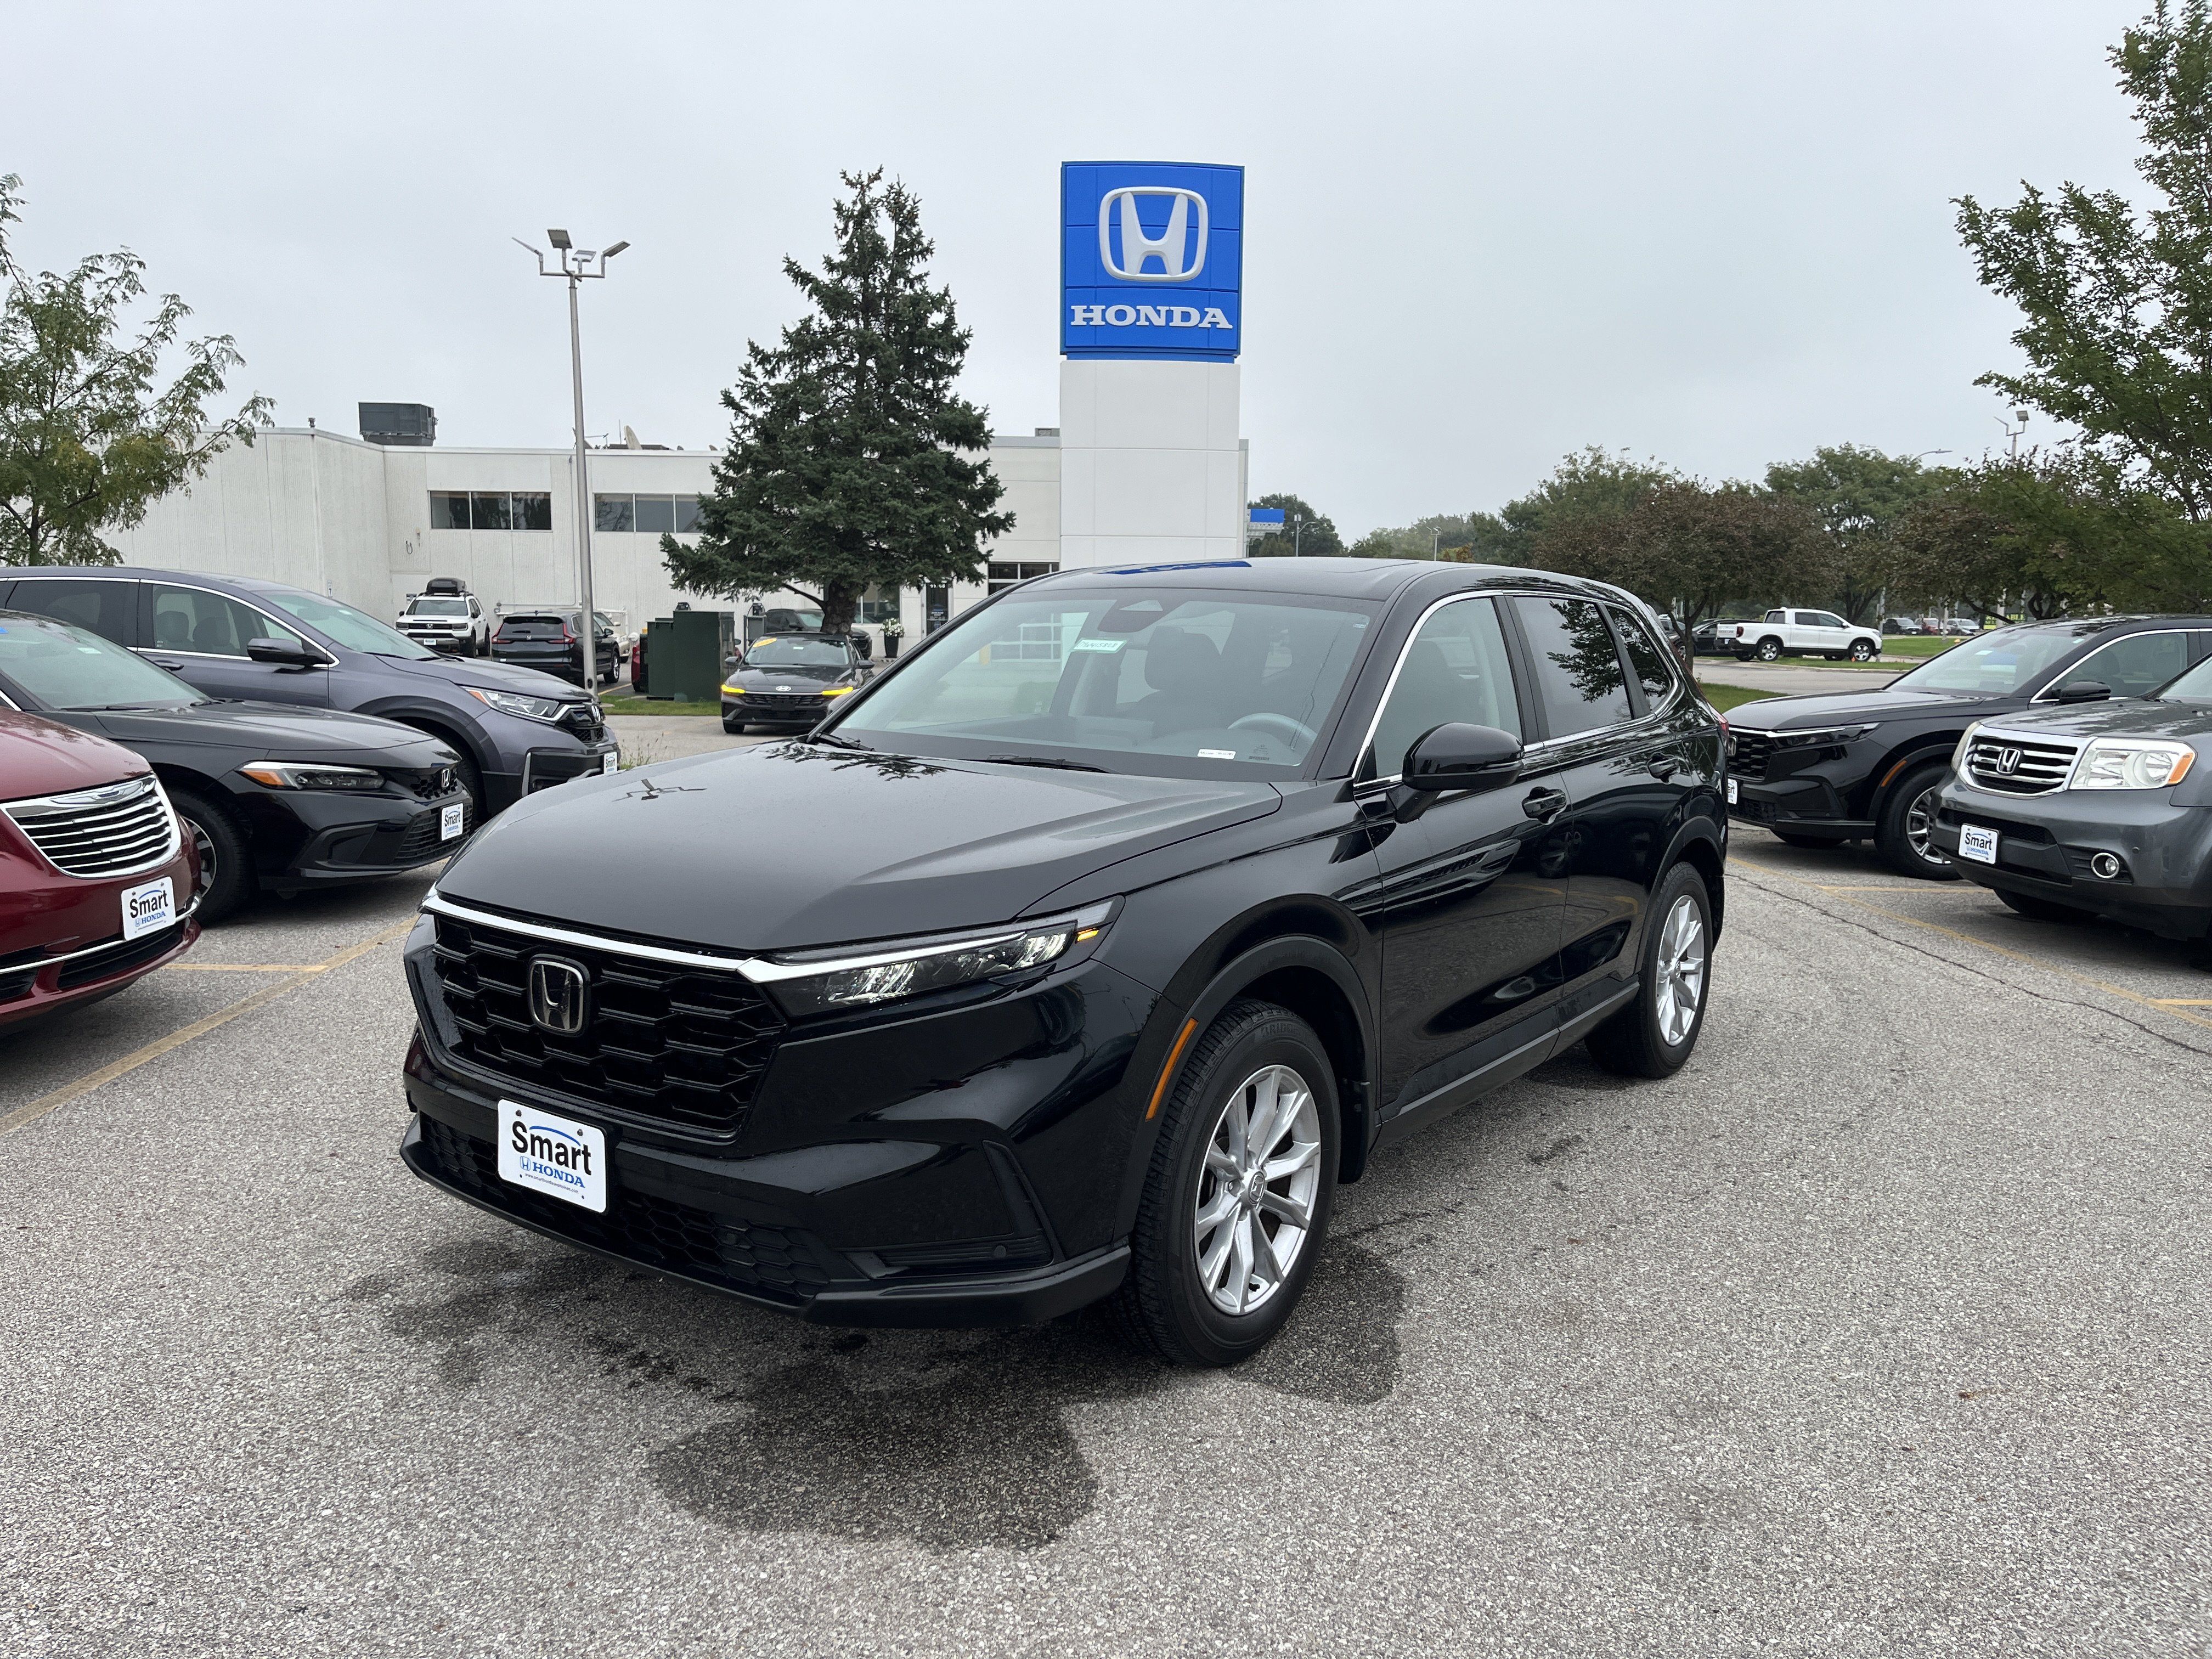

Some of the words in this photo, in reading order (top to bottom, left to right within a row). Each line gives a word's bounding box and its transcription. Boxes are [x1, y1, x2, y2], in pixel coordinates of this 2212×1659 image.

[1070, 304, 1233, 329] HONDA
[444, 811, 461, 827] Smart
[1965, 832, 1993, 851] Smart
[129, 889, 168, 919] Smart
[141, 911, 166, 924] HONDA
[511, 1120, 592, 1176] Smart
[532, 1161, 586, 1188] HONDA
